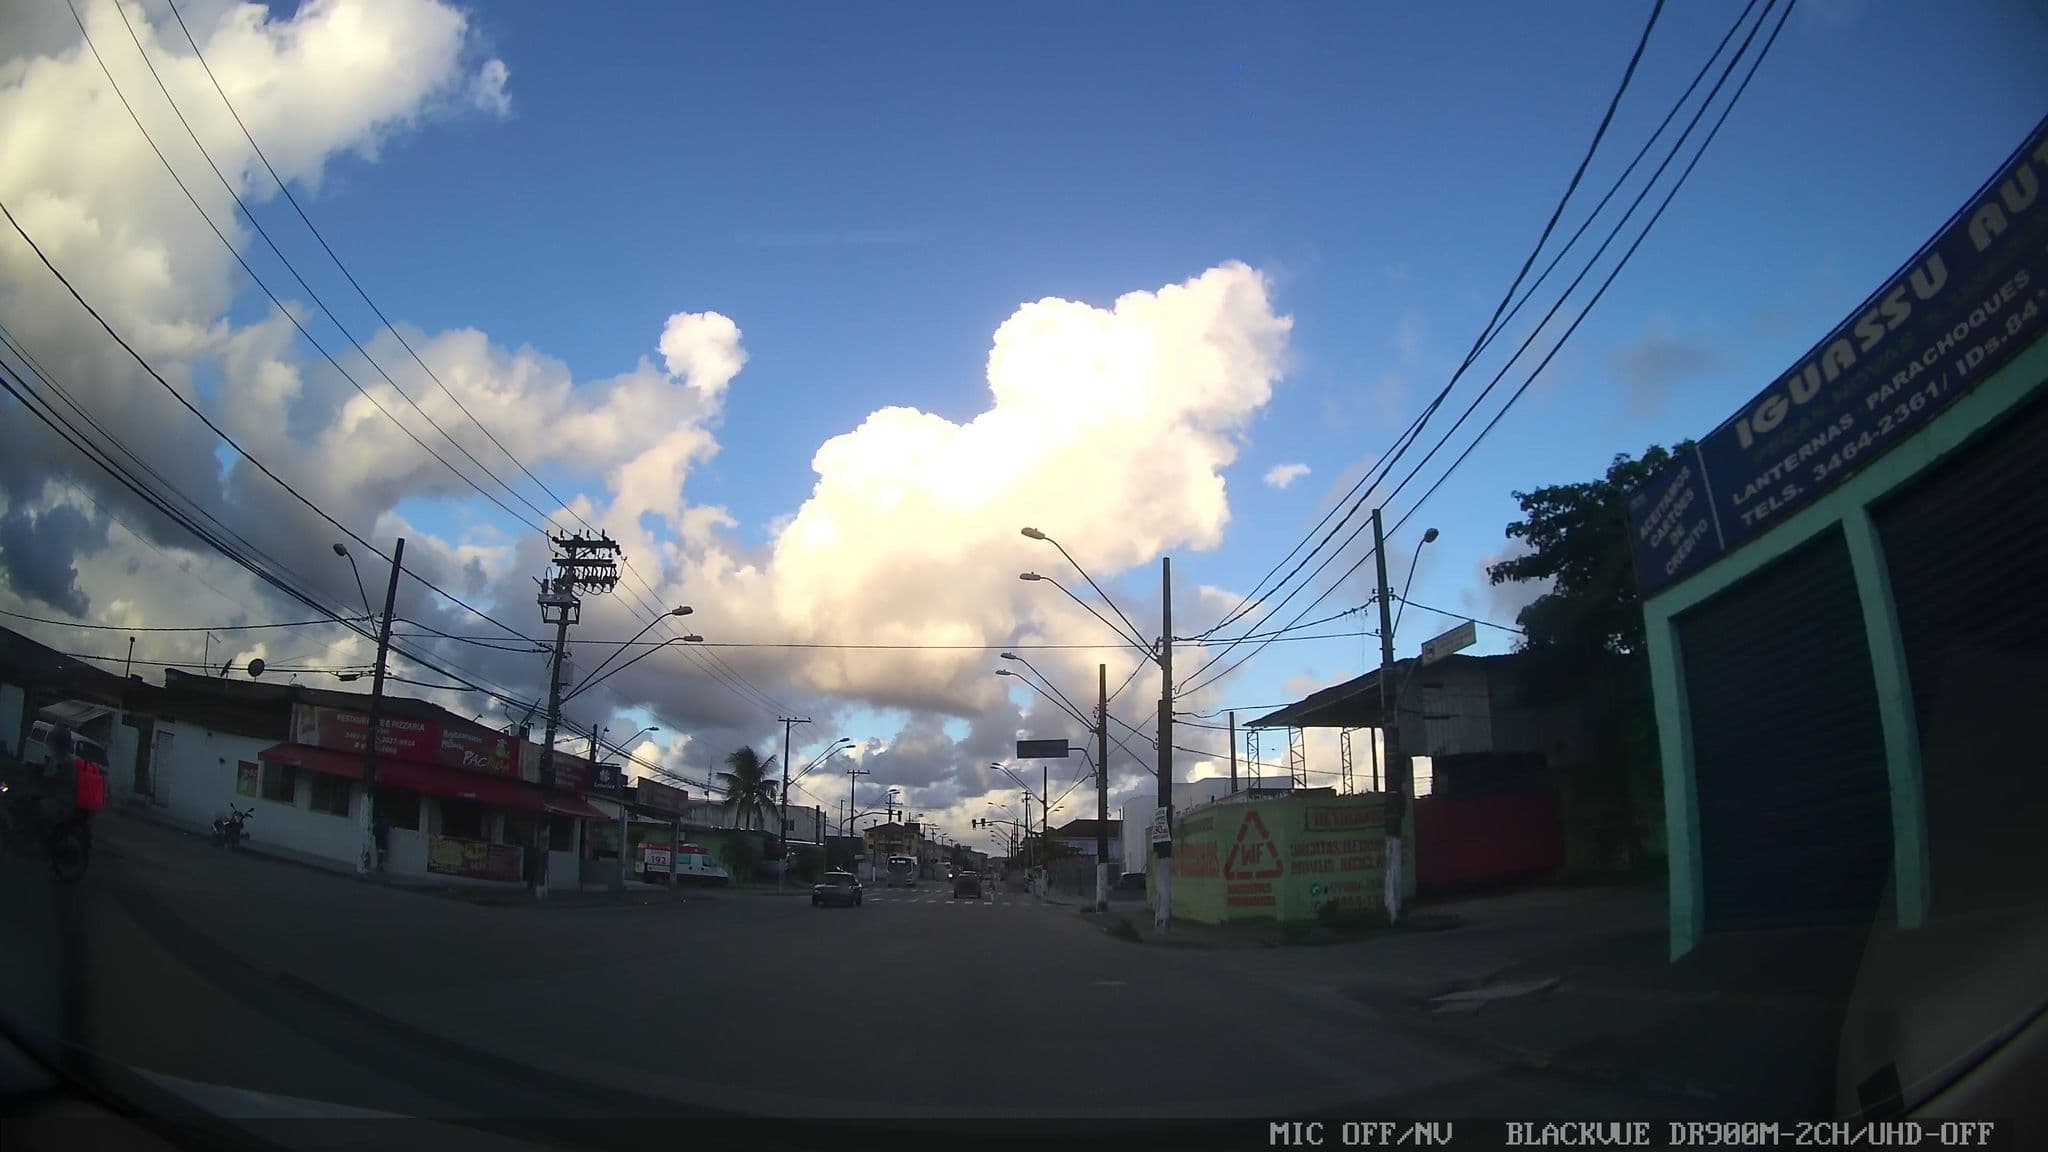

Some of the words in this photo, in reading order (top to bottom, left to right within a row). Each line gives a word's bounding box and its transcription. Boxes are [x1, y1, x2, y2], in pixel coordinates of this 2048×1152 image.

[1732, 412, 1855, 505] LANTERNAS
[1865, 267, 2031, 411] PARACHOQUES
[1735, 252, 1948, 449] IGUASSU
[1739, 482, 1804, 527] TELS.
[650, 855, 667, 865] 192
